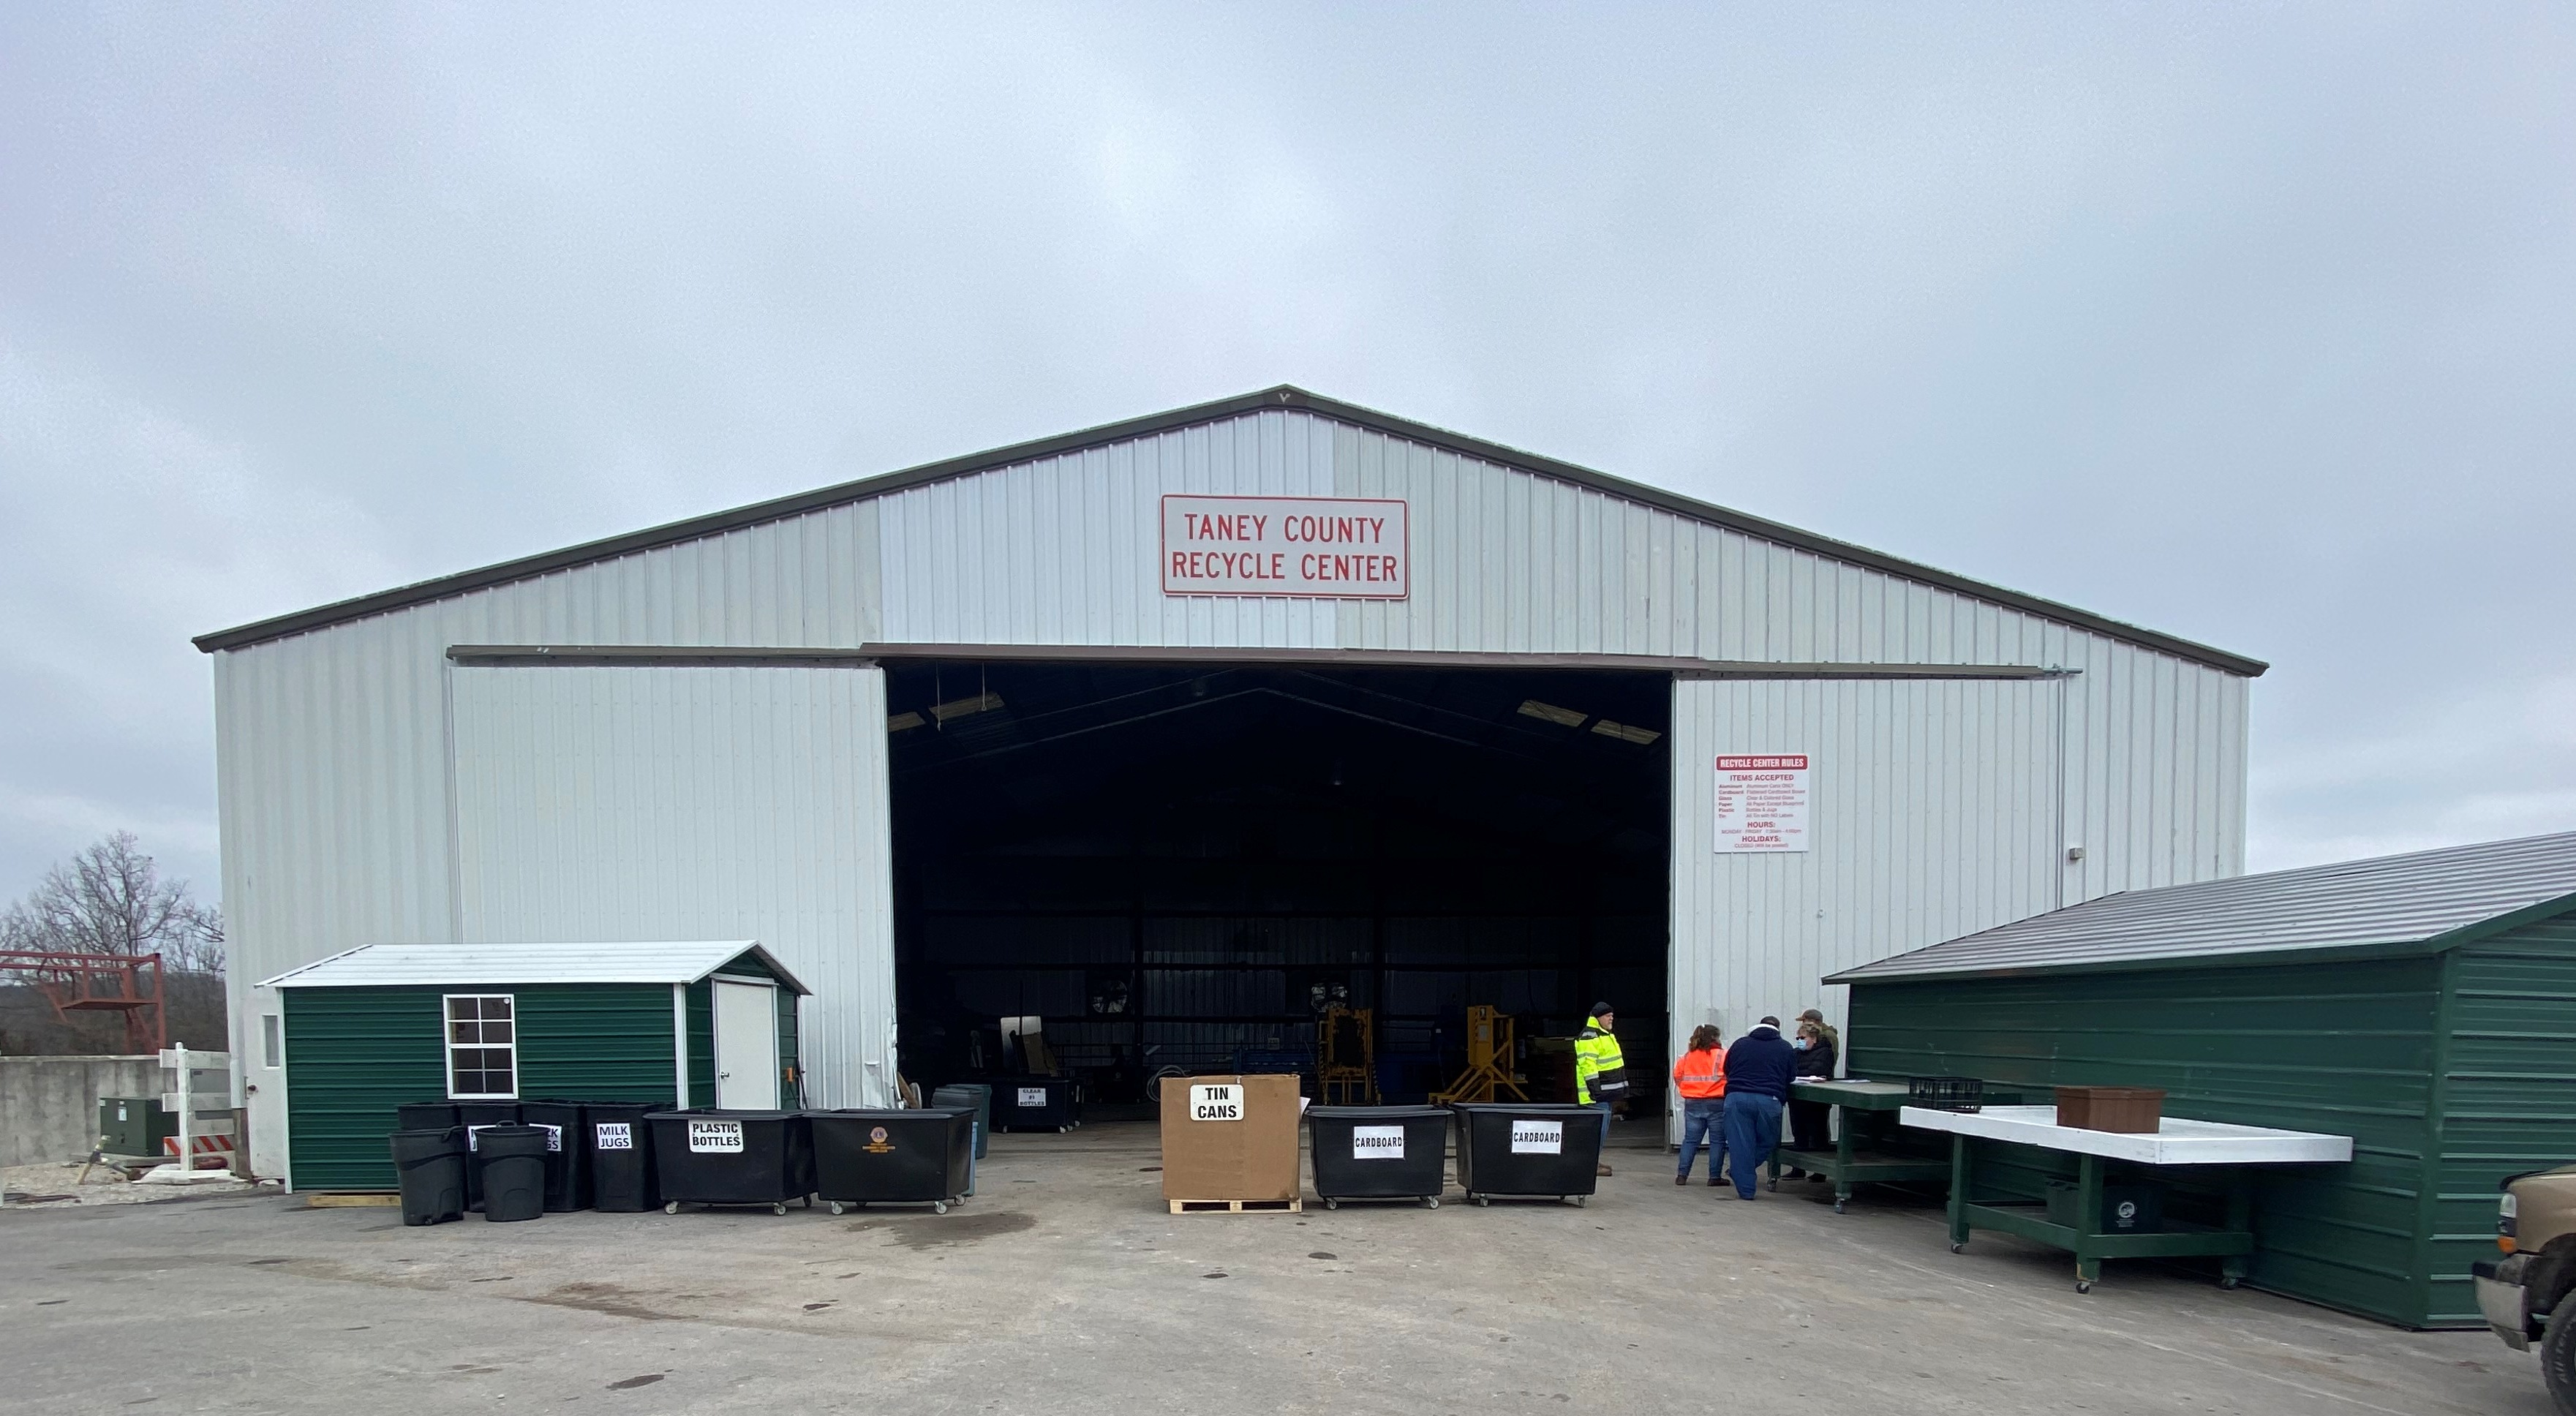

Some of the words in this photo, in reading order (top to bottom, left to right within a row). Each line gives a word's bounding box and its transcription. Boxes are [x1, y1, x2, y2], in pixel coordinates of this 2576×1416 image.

[1184, 513, 1268, 541] TANEY
[1284, 515, 1385, 543] COUNTY
[1172, 551, 1285, 579] RECYCLE
[1301, 554, 1397, 581] CENTER
[1720, 759, 1751, 767] RECYCLE
[1753, 758, 1780, 767] CENTER
[1782, 758, 1804, 767] RULES
[1205, 1087, 1228, 1100] TIN
[1197, 1105, 1237, 1118] CANS
[600, 1126, 628, 1135] MILK
[693, 1123, 738, 1133] PLASTIC
[600, 1137, 629, 1147] JUGS
[693, 1137, 740, 1146] BOTTLES
[1355, 1137, 1403, 1147] CARDBOARD
[1514, 1132, 1560, 1142] CARDBOARD
